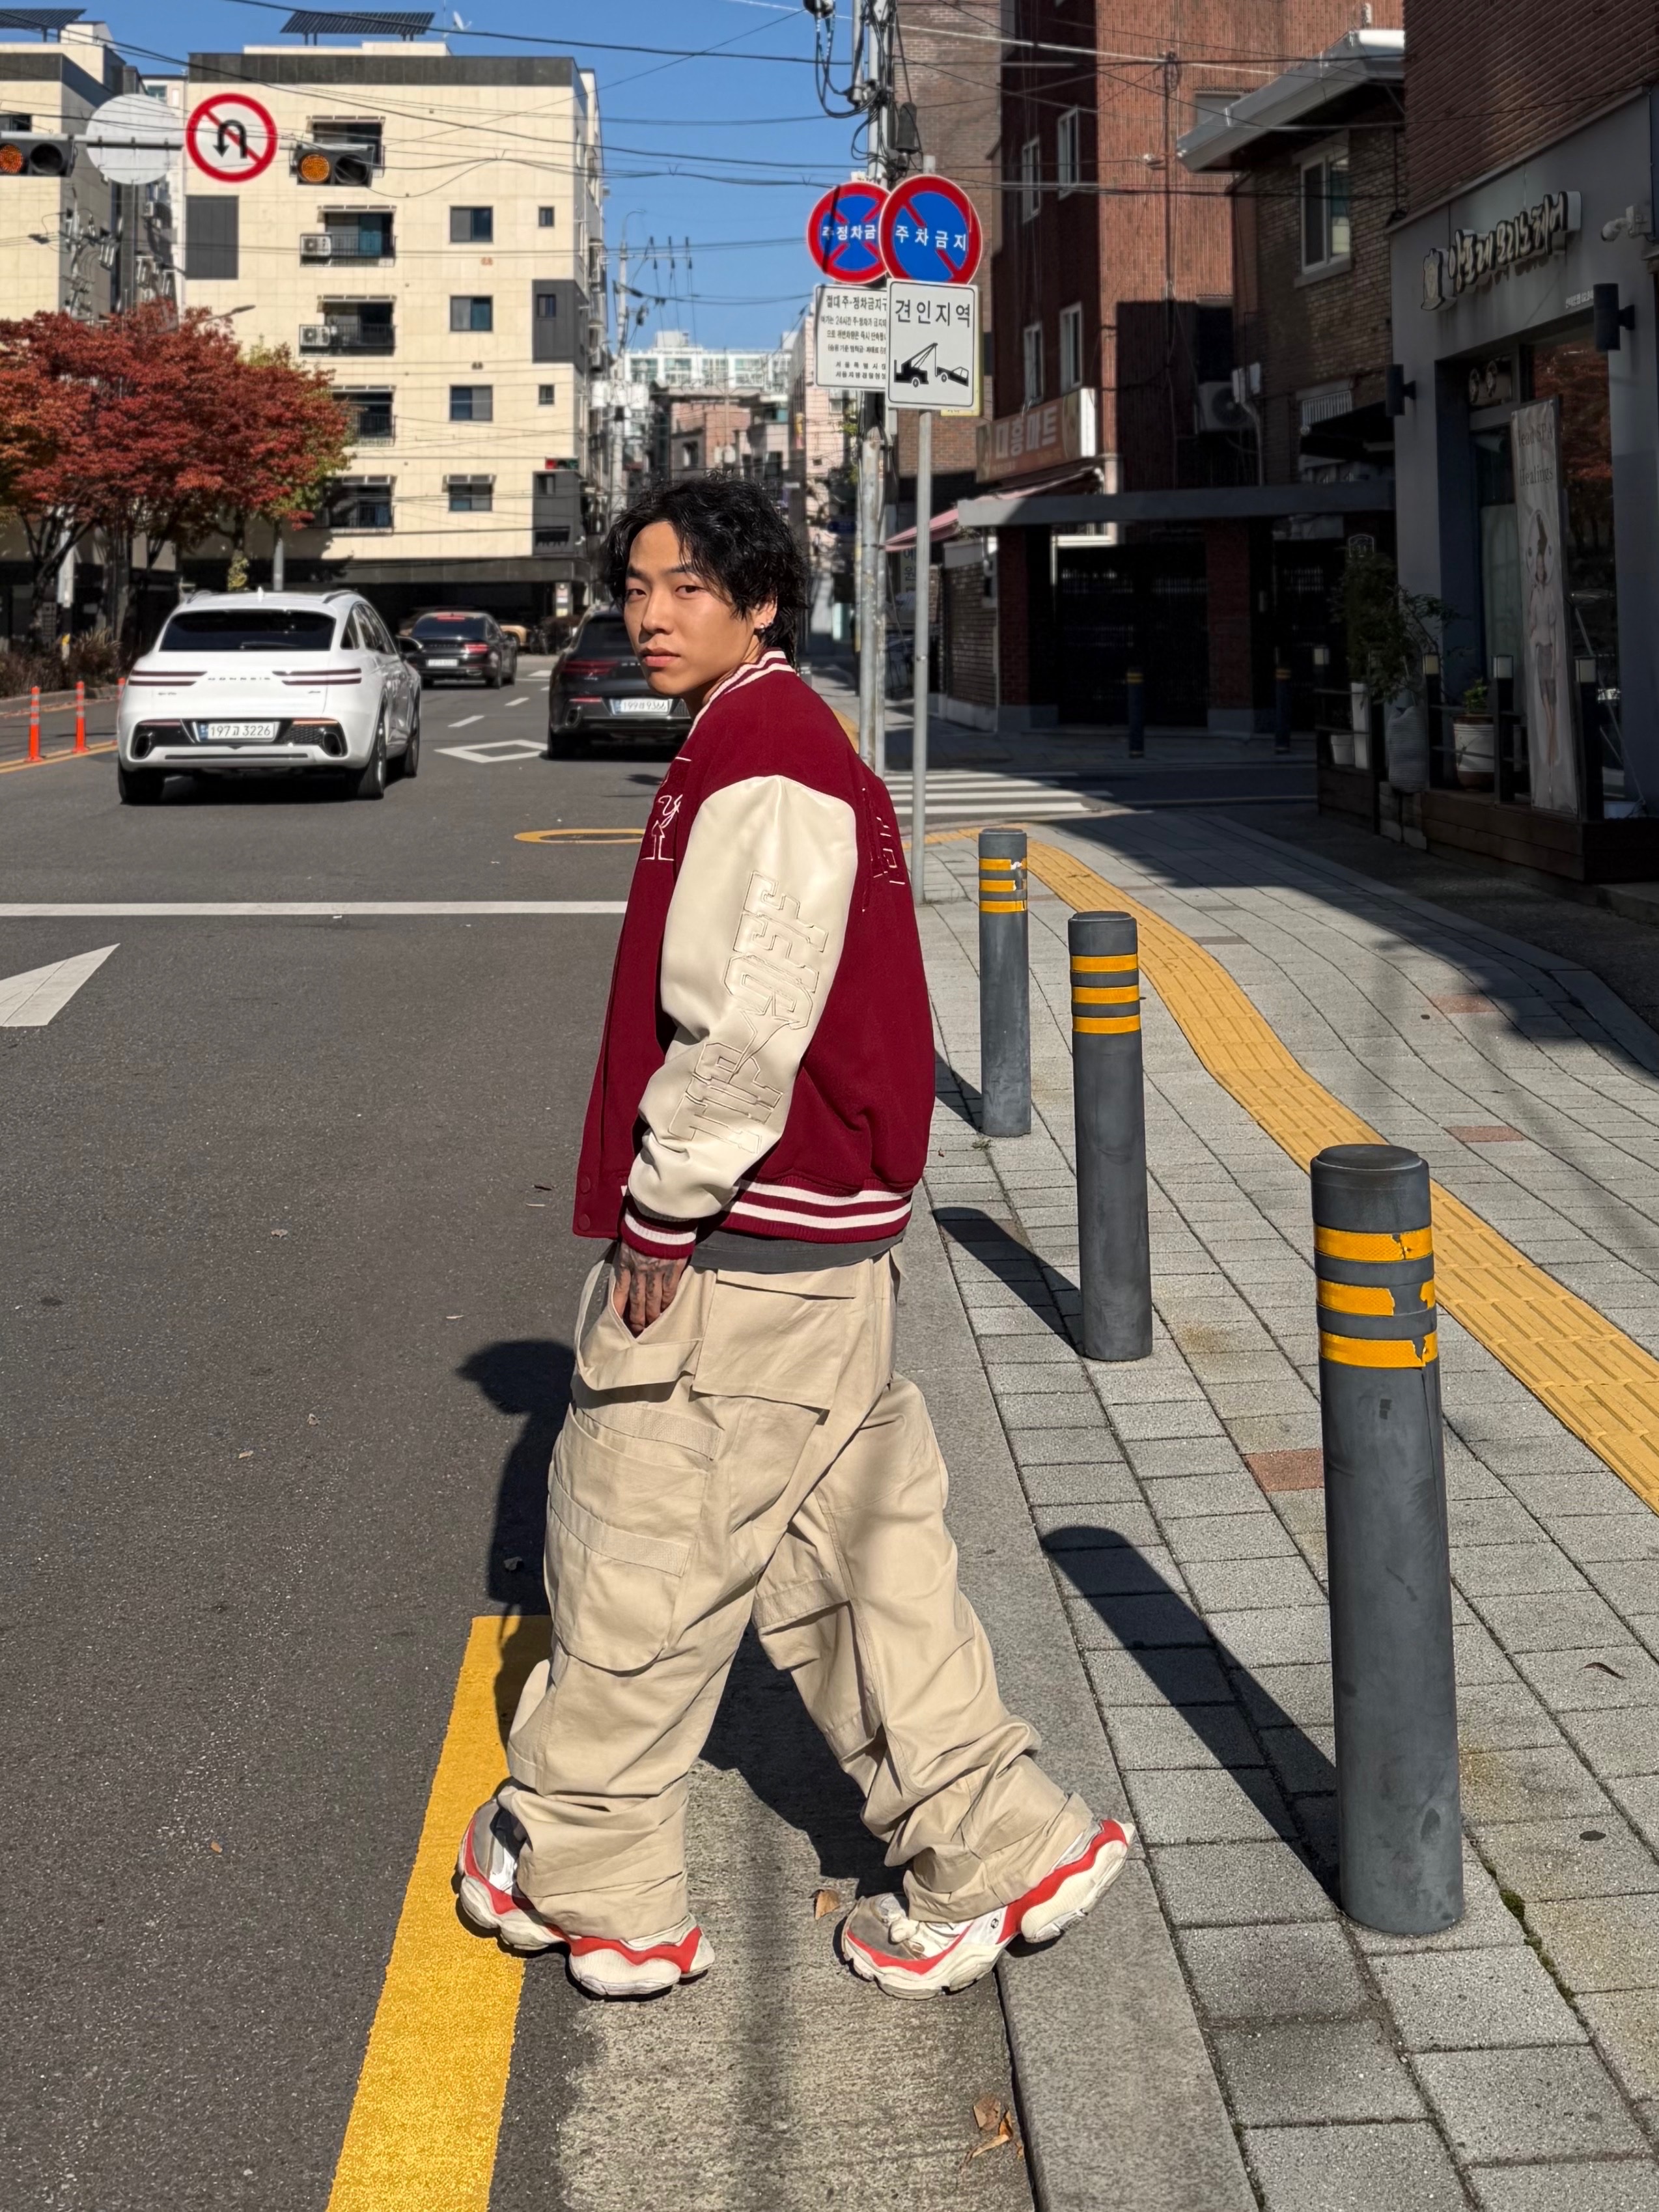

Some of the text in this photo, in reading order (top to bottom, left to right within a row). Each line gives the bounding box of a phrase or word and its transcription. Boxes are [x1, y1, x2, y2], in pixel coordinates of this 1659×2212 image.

[895, 224, 967, 252] 주차금지
[895, 298, 970, 328] 견인지역
[1519, 464, 1554, 487] Healings
[242, 725, 271, 736] 3226
